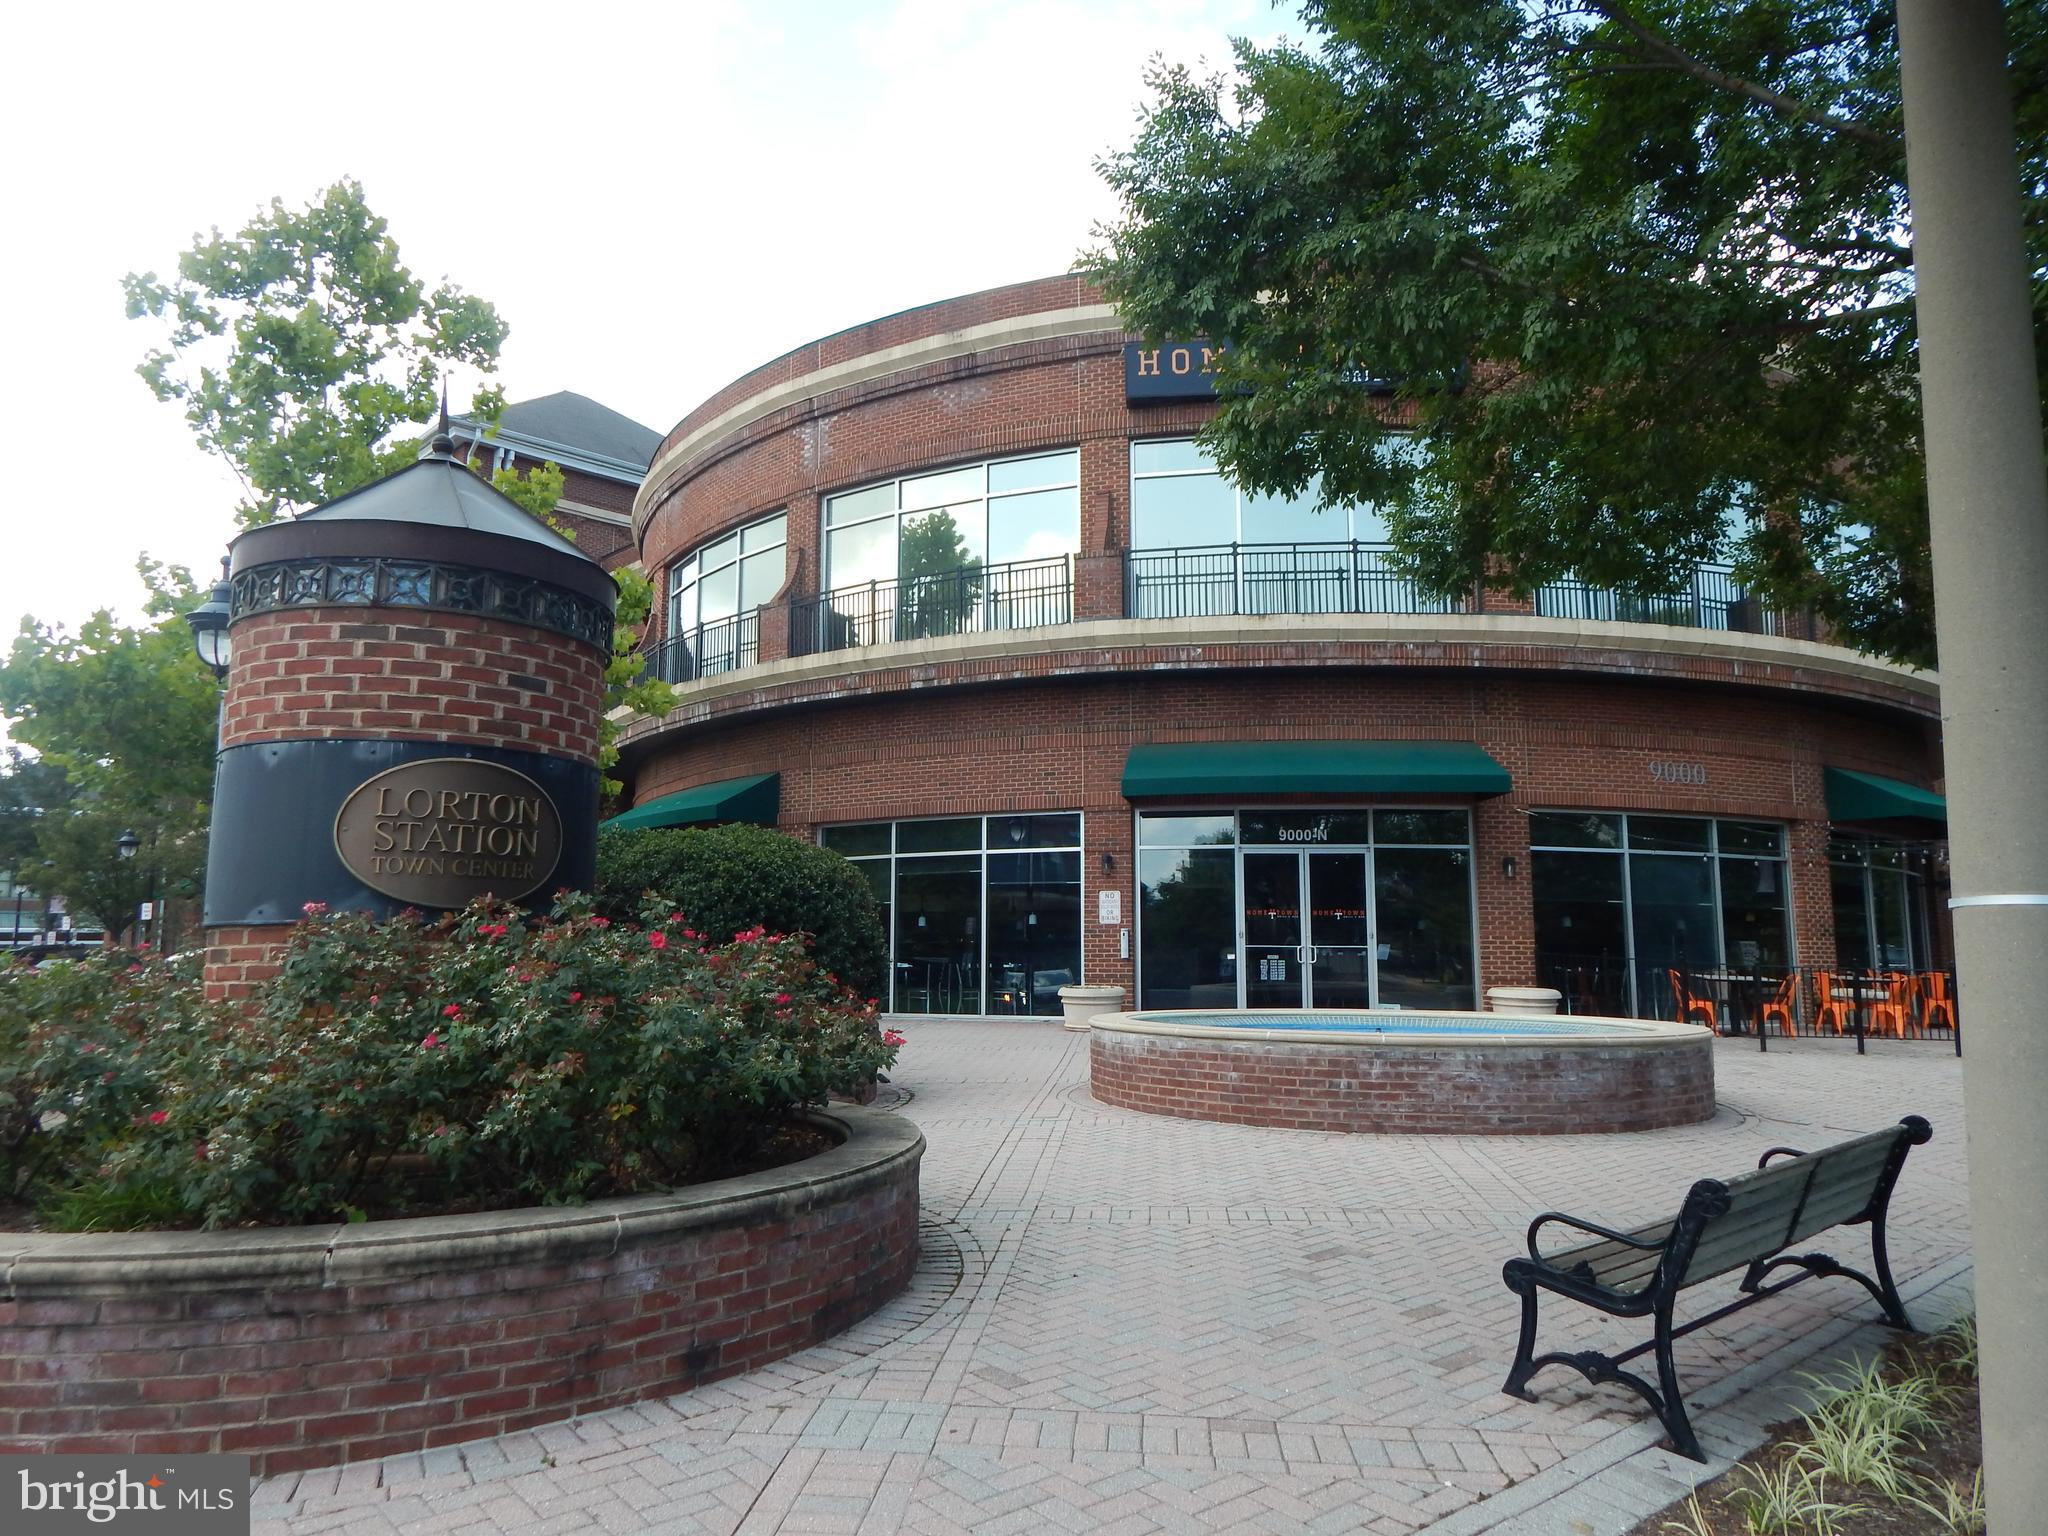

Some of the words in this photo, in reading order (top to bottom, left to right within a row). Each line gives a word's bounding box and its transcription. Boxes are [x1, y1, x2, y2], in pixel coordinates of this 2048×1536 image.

[1648, 760, 1706, 785] 9000
[374, 787, 541, 825] LORTON
[373, 820, 540, 857] STATION
[370, 855, 445, 876] TOWN
[451, 858, 535, 880] CENTER
